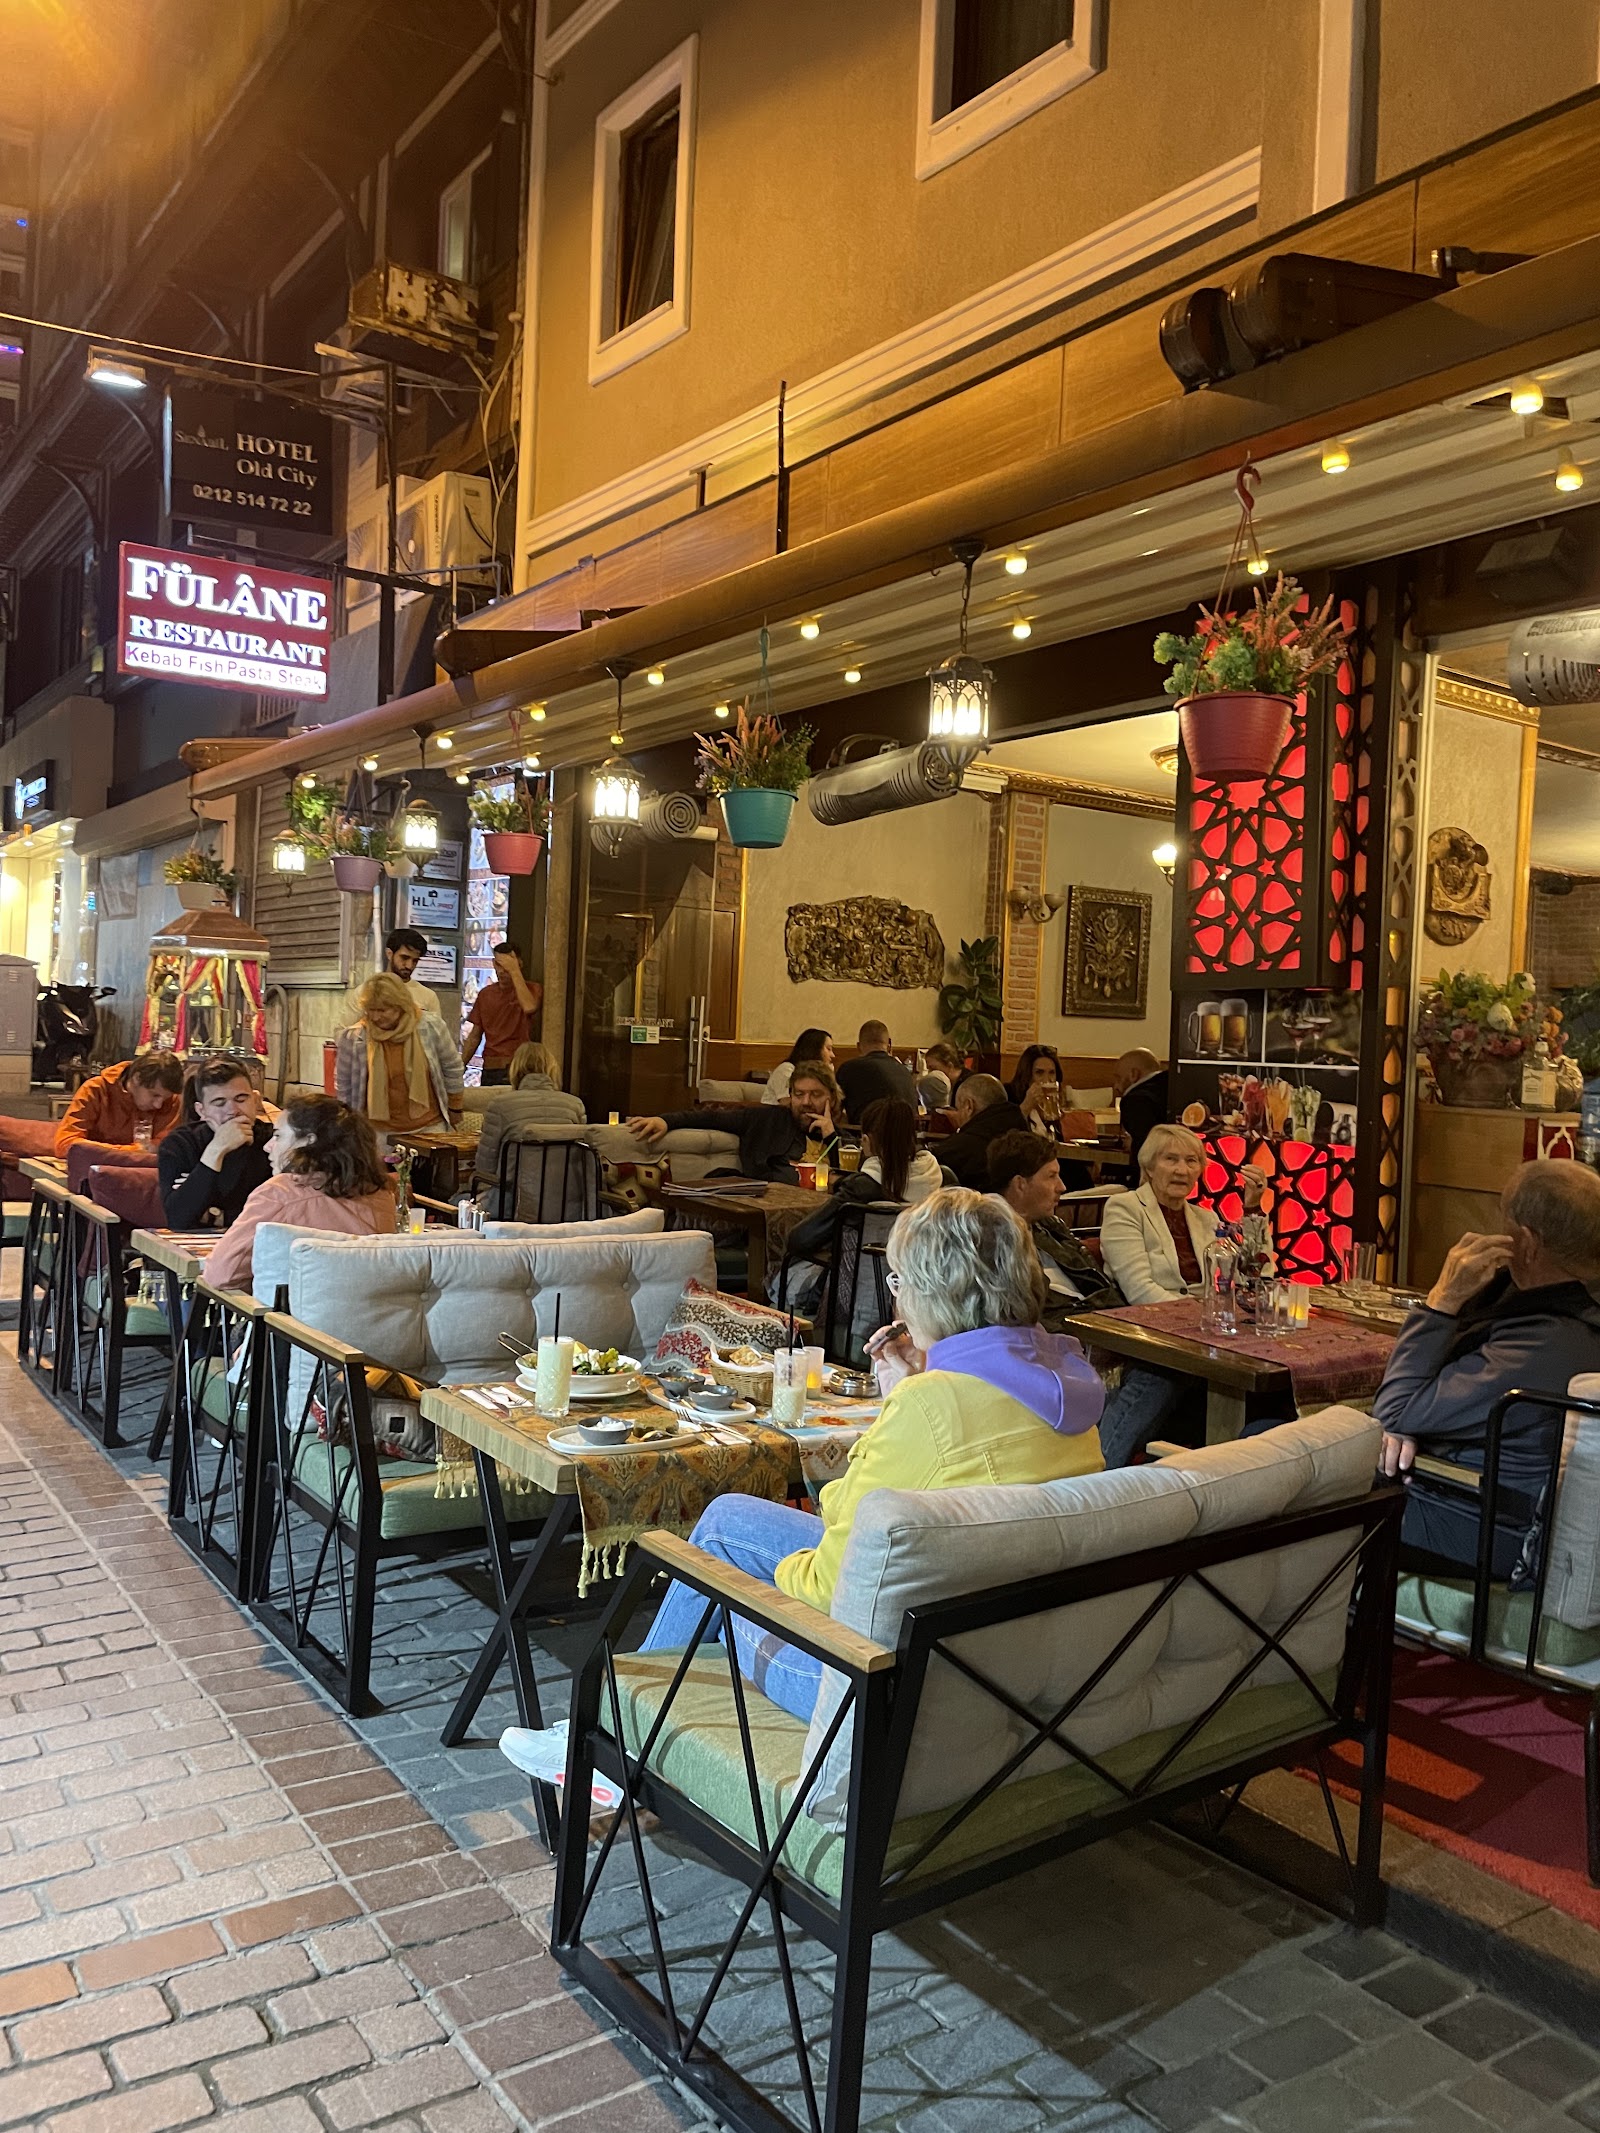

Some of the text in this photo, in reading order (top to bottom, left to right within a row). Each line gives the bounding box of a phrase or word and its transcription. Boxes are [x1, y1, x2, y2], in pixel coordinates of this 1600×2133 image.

[237, 433, 318, 463] HOTEL
[236, 459, 318, 490] Old City
[193, 485, 312, 516] 0212 514 72 22
[127, 557, 328, 630] FÜLÂNE
[129, 615, 326, 667] RESTAURANT
[126, 645, 182, 668] Kebab
[227, 661, 272, 681] Pasta
[278, 669, 322, 690] Steak
